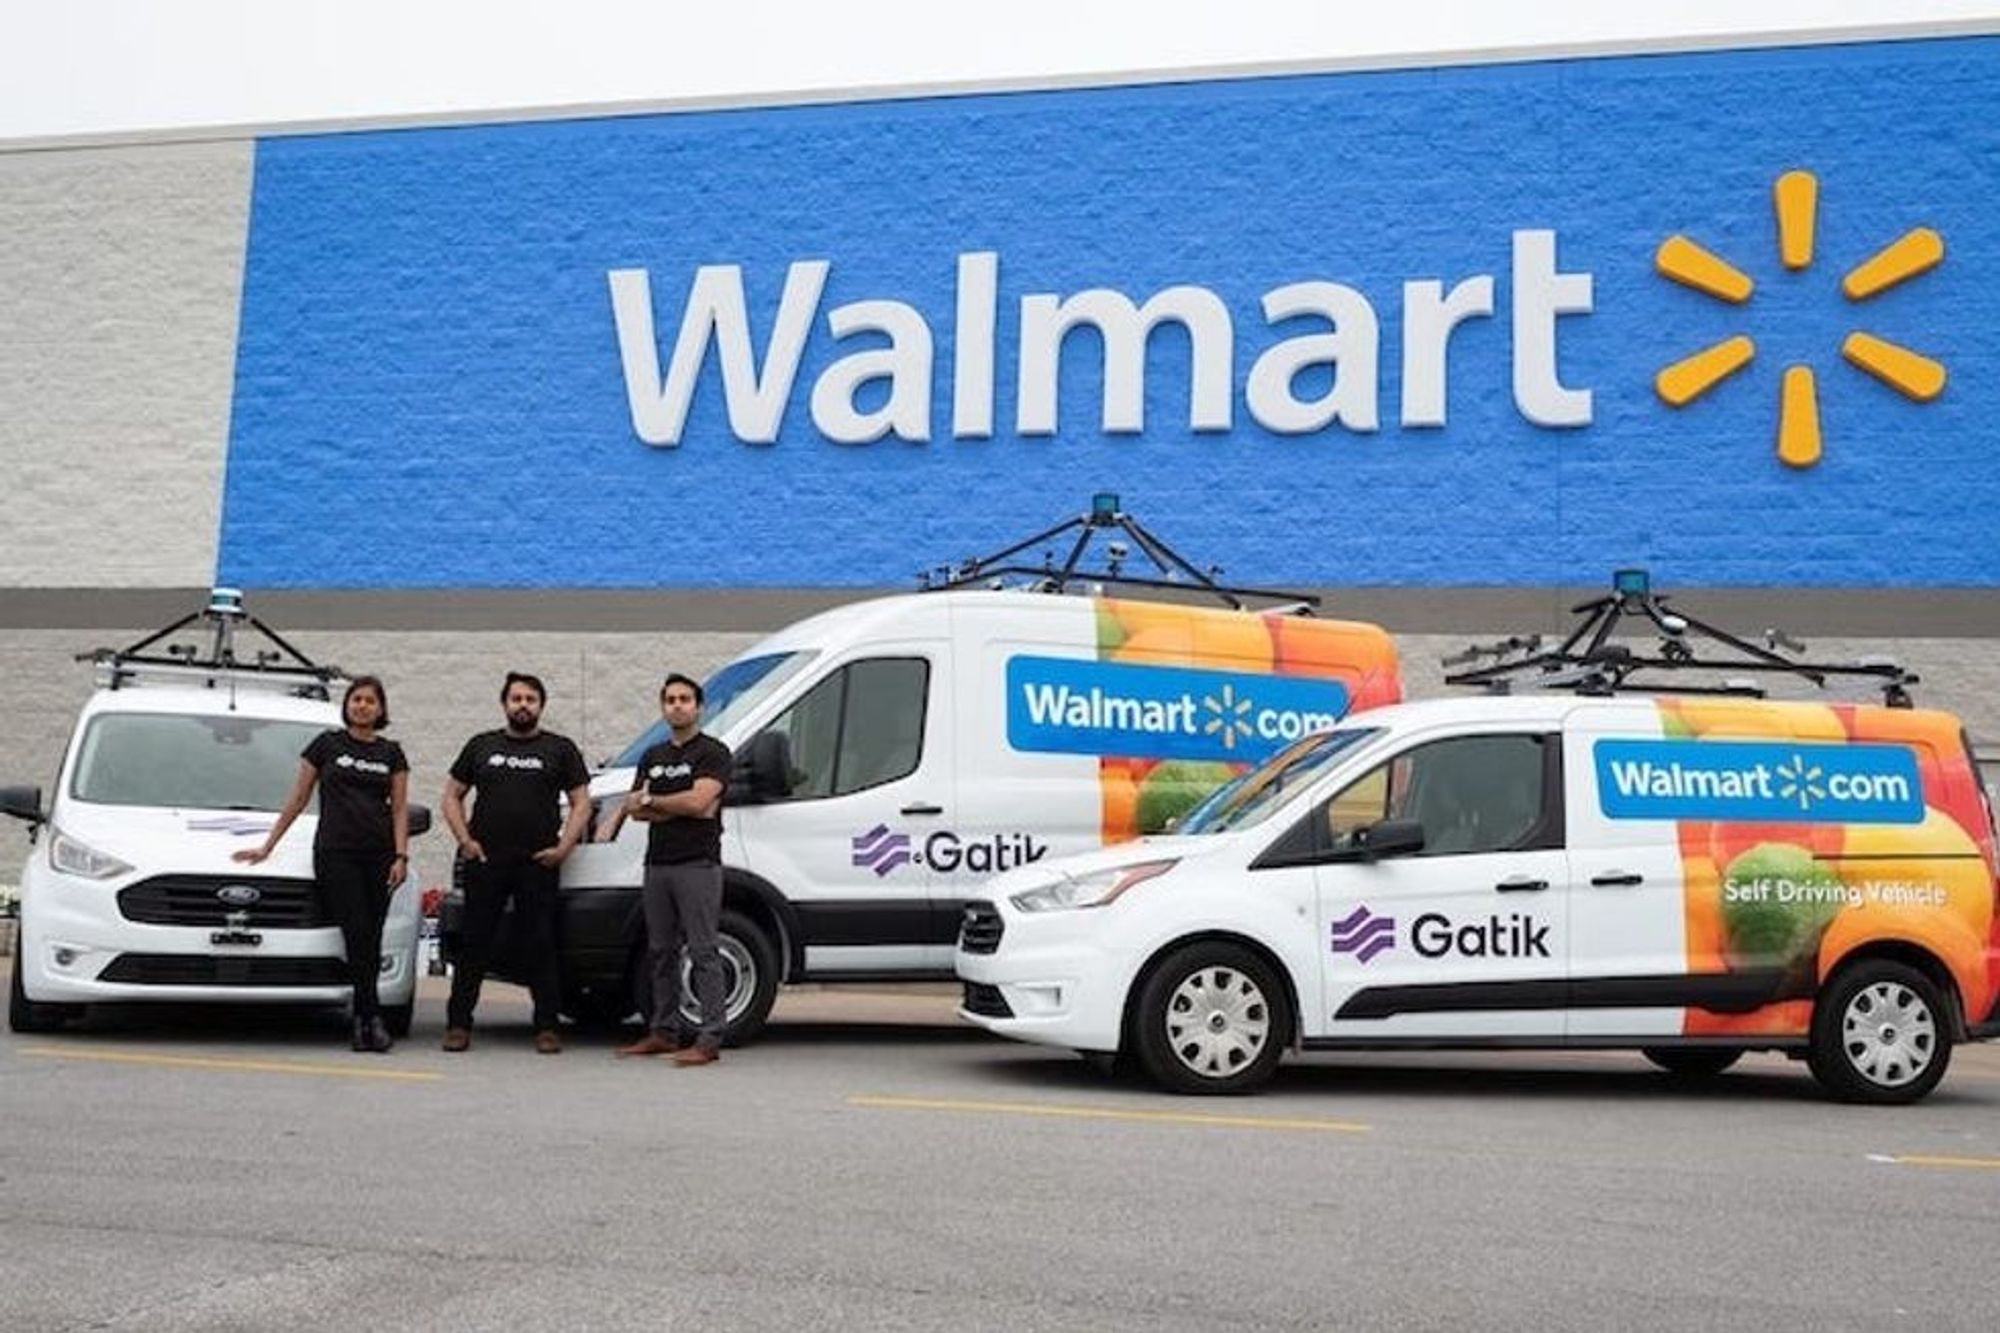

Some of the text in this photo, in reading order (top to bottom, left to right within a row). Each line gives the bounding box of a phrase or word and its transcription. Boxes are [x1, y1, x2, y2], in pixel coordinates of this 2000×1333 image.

[608, 229, 1593, 447] Walmart
[1023, 683, 1197, 733] Walmart
[1610, 761, 1910, 801] Walmart com
[1724, 878, 1948, 908] Self Driving Vehicle
[1411, 913, 1550, 959] Gatik
